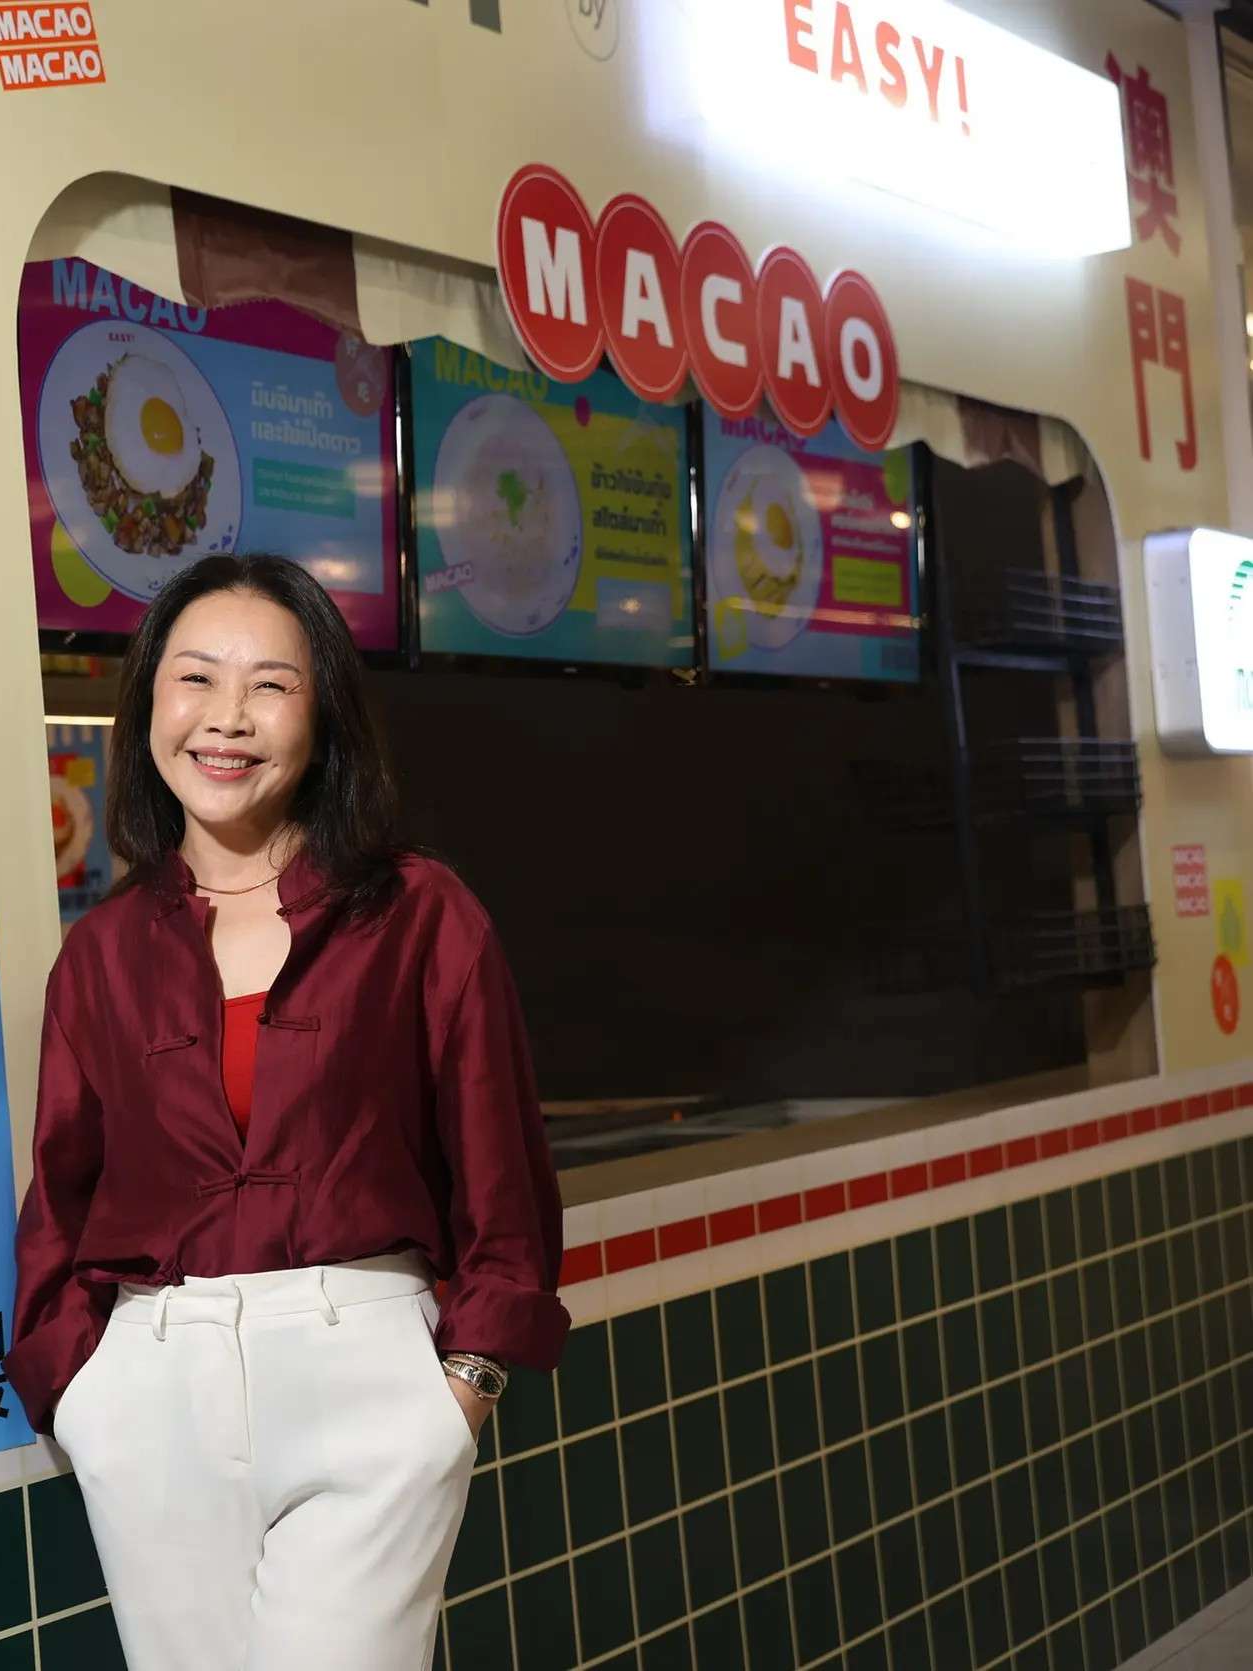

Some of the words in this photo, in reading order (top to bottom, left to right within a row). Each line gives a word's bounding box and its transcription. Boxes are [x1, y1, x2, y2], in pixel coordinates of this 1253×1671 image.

[0, 49, 101, 85] MACAO
[782, 0, 971, 136] EASY!
[520, 215, 884, 402] MACAO
